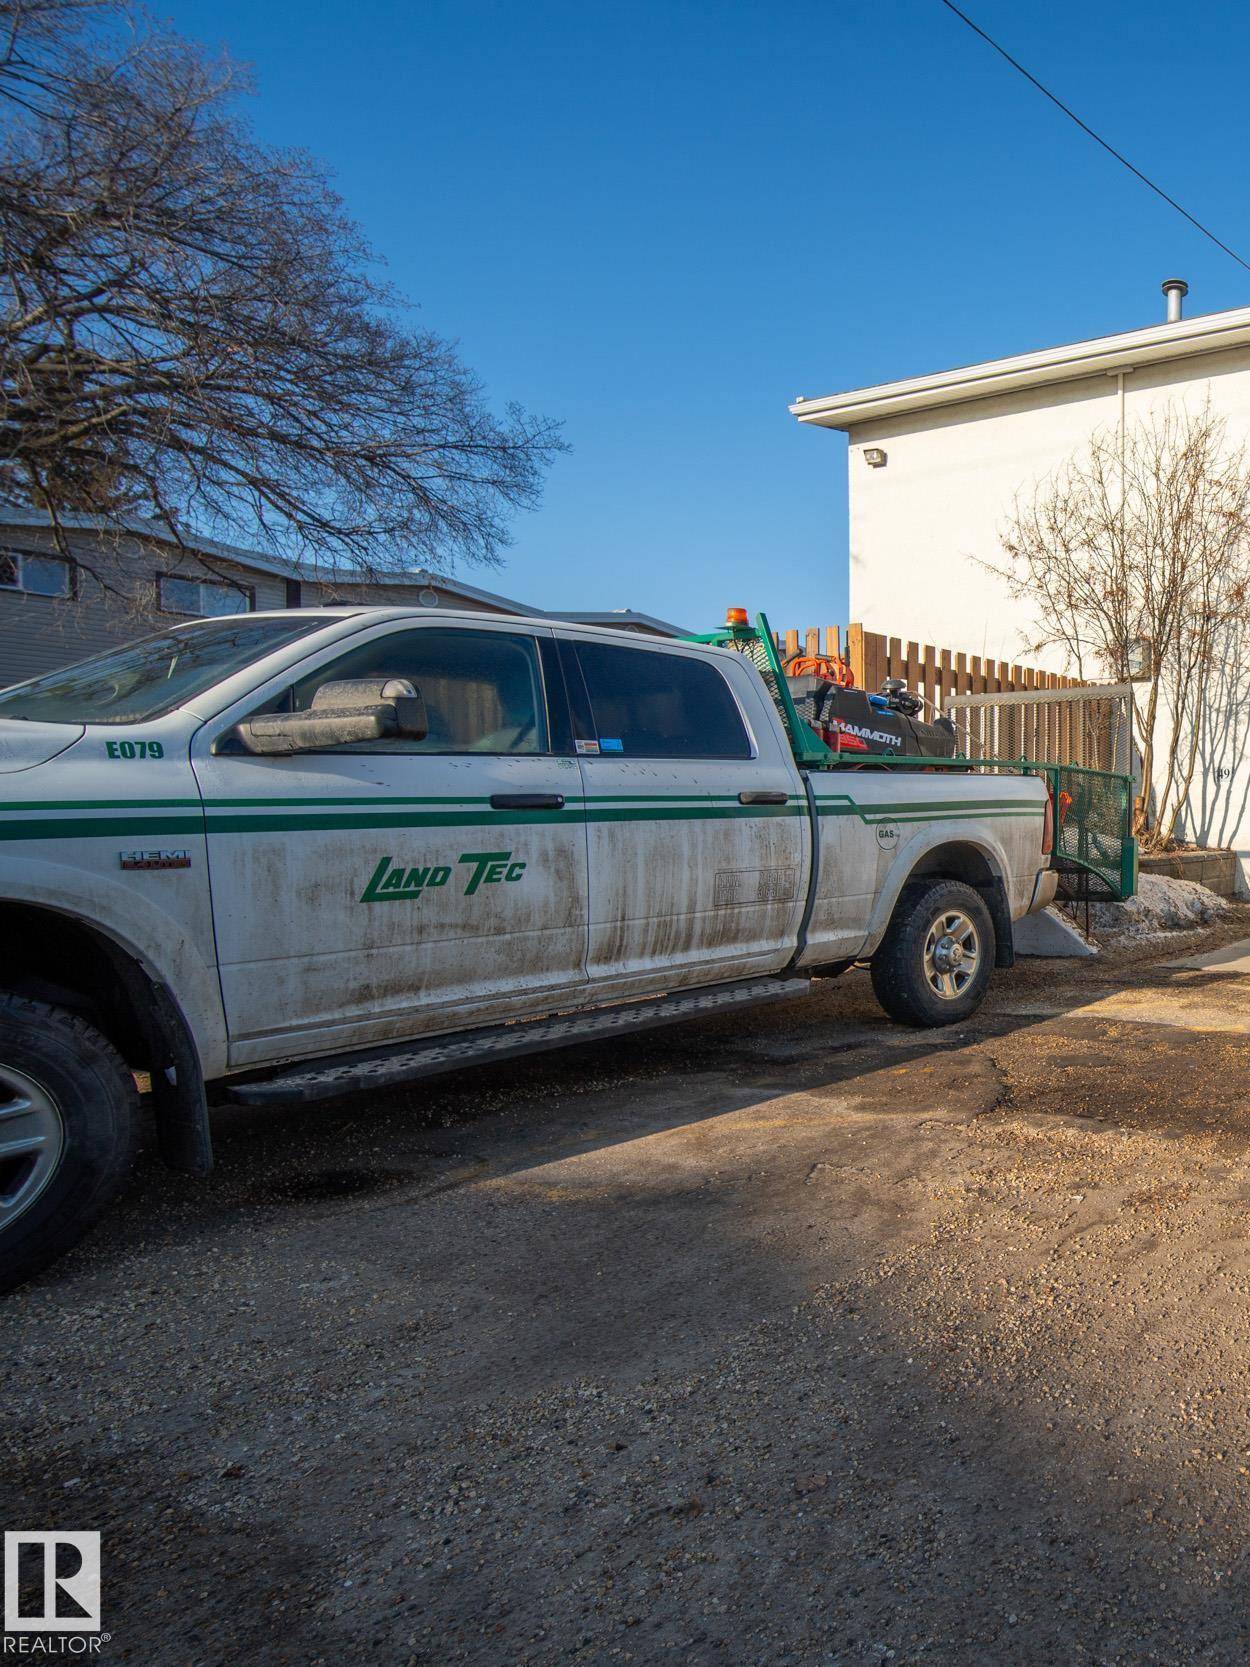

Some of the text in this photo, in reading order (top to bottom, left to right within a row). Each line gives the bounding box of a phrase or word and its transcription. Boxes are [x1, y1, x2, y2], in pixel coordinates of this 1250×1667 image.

[105, 741, 164, 759] E079
[1216, 768, 1230, 780] 49
[878, 830, 895, 839] GAS
[120, 850, 191, 861] HEMI
[359, 851, 527, 904] LAND TEC
